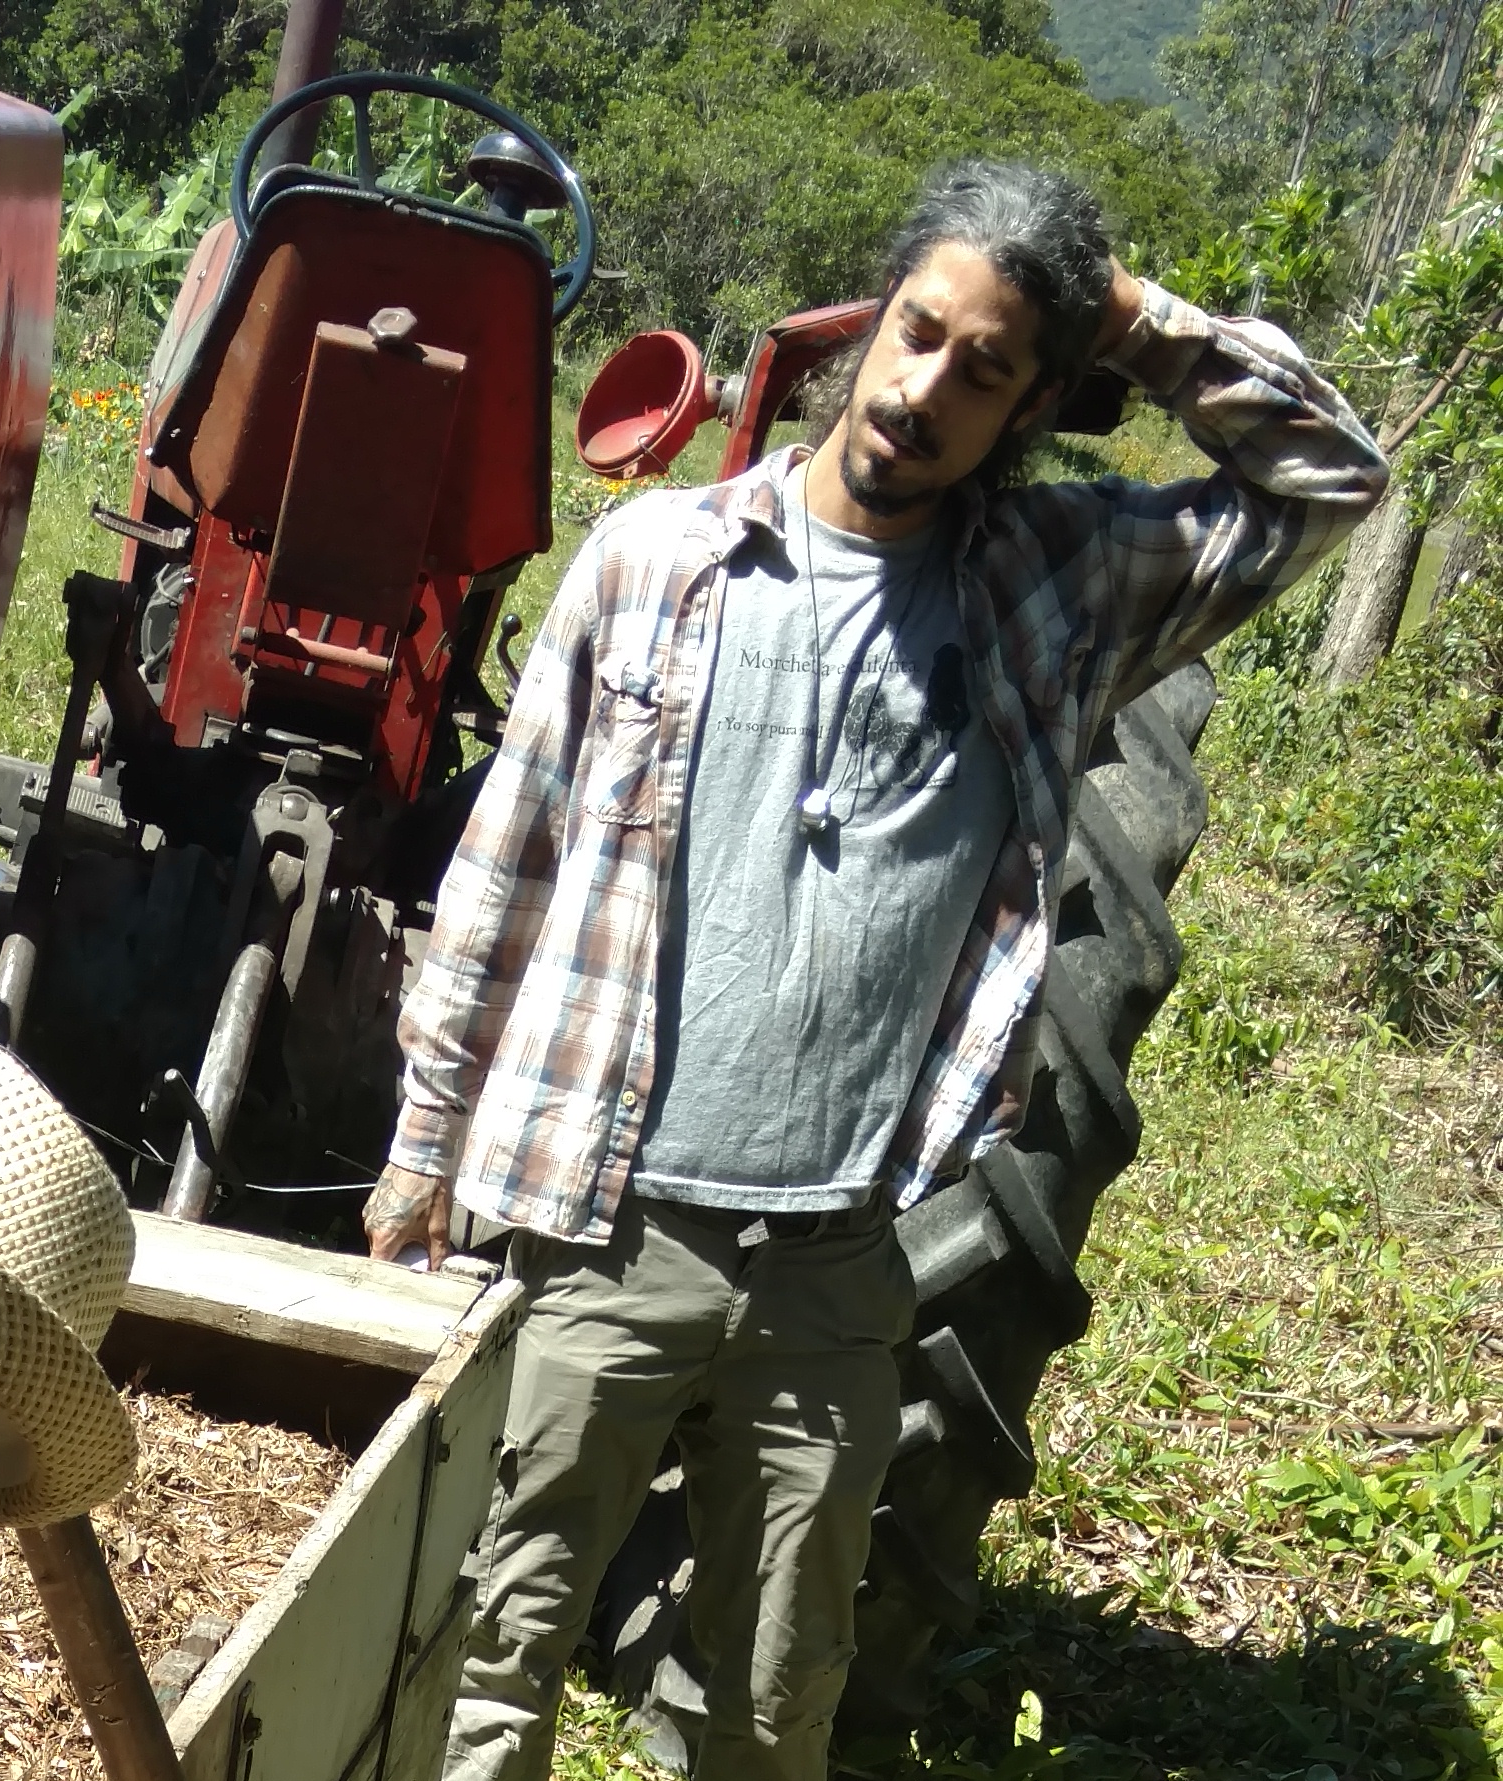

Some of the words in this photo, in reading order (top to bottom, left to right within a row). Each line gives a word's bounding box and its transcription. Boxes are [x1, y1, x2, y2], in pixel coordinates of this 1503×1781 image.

[739, 648, 830, 677] Morchela
[838, 654, 920, 675] eculenta.
[745, 722, 764, 736] soy
[769, 724, 797, 739] pura
